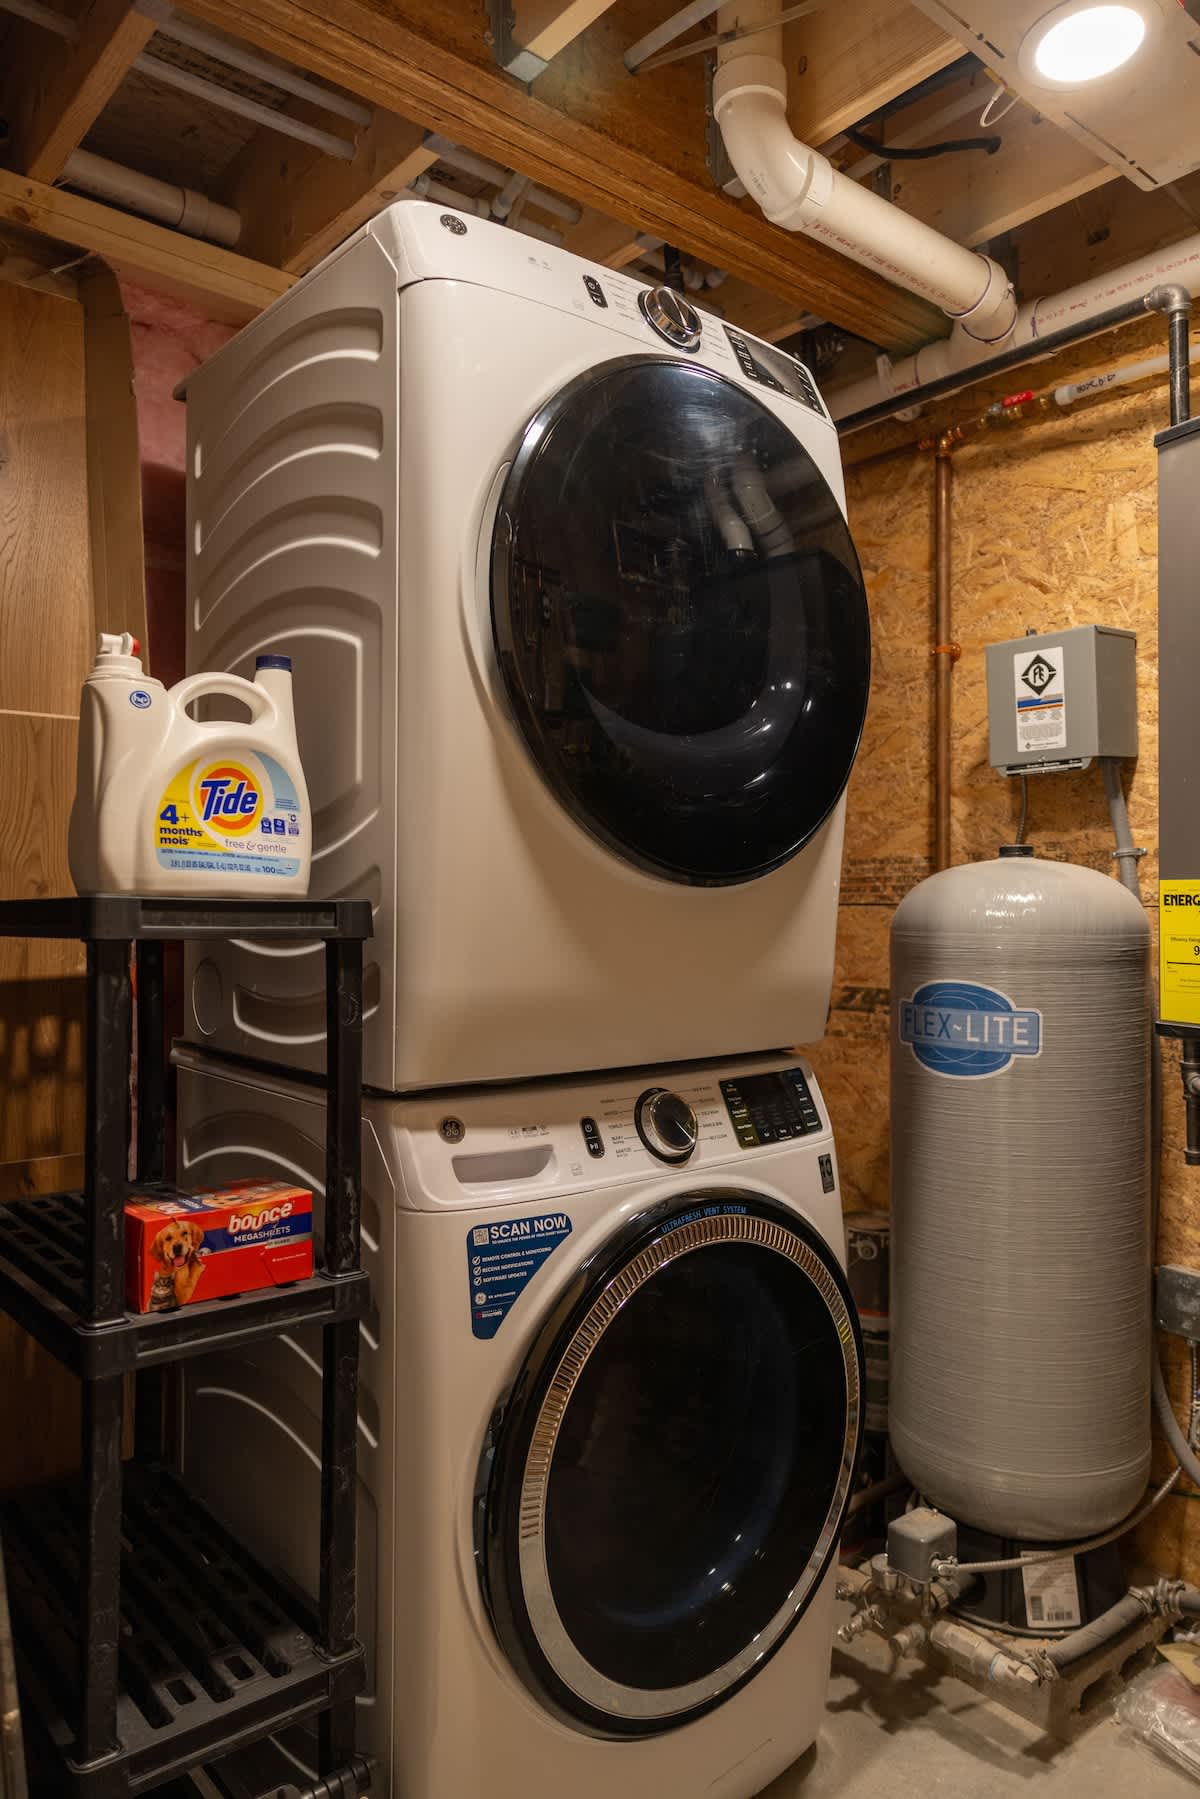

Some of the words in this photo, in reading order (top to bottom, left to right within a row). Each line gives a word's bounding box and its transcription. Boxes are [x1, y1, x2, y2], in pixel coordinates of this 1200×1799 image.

[200, 779, 258, 821] Tide
[225, 838, 245, 848] free
[257, 842, 287, 854] gentle
[262, 865, 276, 874] 100
[229, 1203, 292, 1233] bounce
[490, 1220, 531, 1239] SCAN
[534, 1215, 567, 1232] NOW
[661, 1209, 702, 1233] ULTRAFRESH
[703, 1206, 720, 1217] VENT
[723, 1205, 747, 1214] SYSTEM
